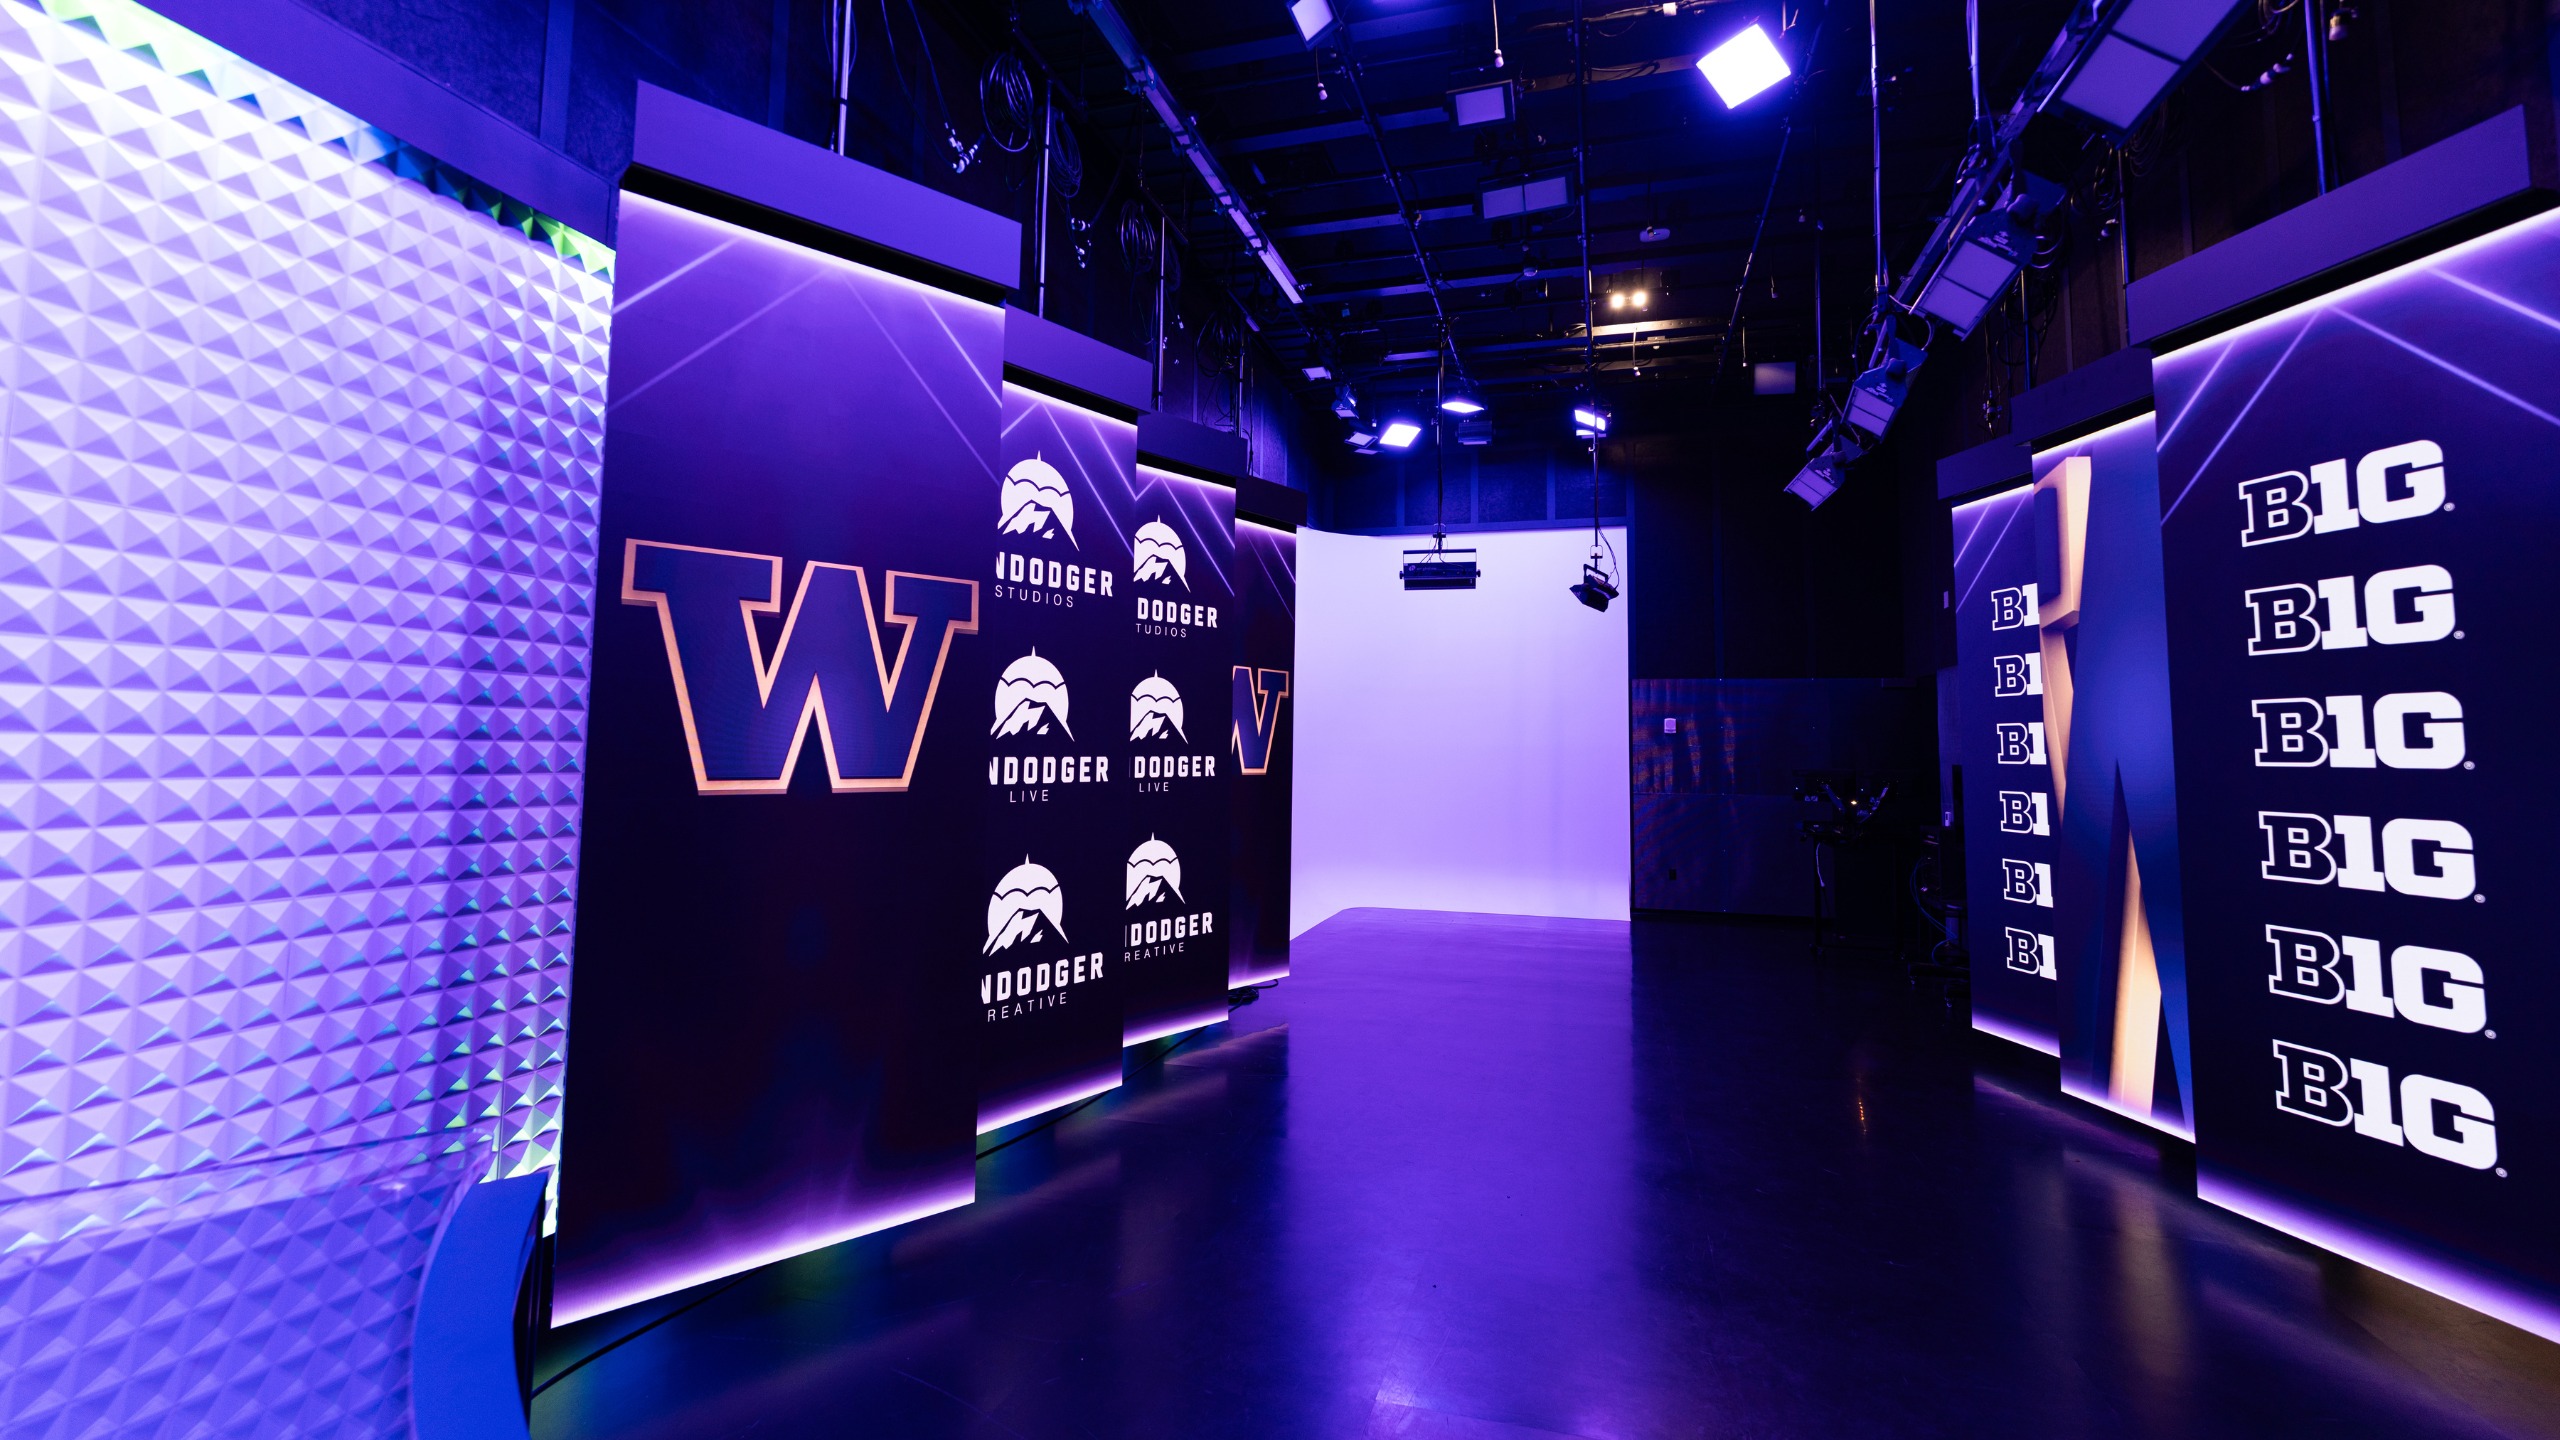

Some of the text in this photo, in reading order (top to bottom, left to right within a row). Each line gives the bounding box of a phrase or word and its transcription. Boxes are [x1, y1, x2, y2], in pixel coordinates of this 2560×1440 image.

[995, 584, 1074, 608] STUDIOS
[1136, 623, 1187, 638] TUDIOS
[622, 538, 980, 796] W
[1129, 755, 1216, 779] DODGER
[1010, 789, 1049, 803] LIVE
[1139, 781, 1169, 793] LIVE
[1124, 912, 1213, 948] DODGER
[1124, 942, 1184, 962] REATIVE
[988, 991, 1067, 1022] REATIVE
